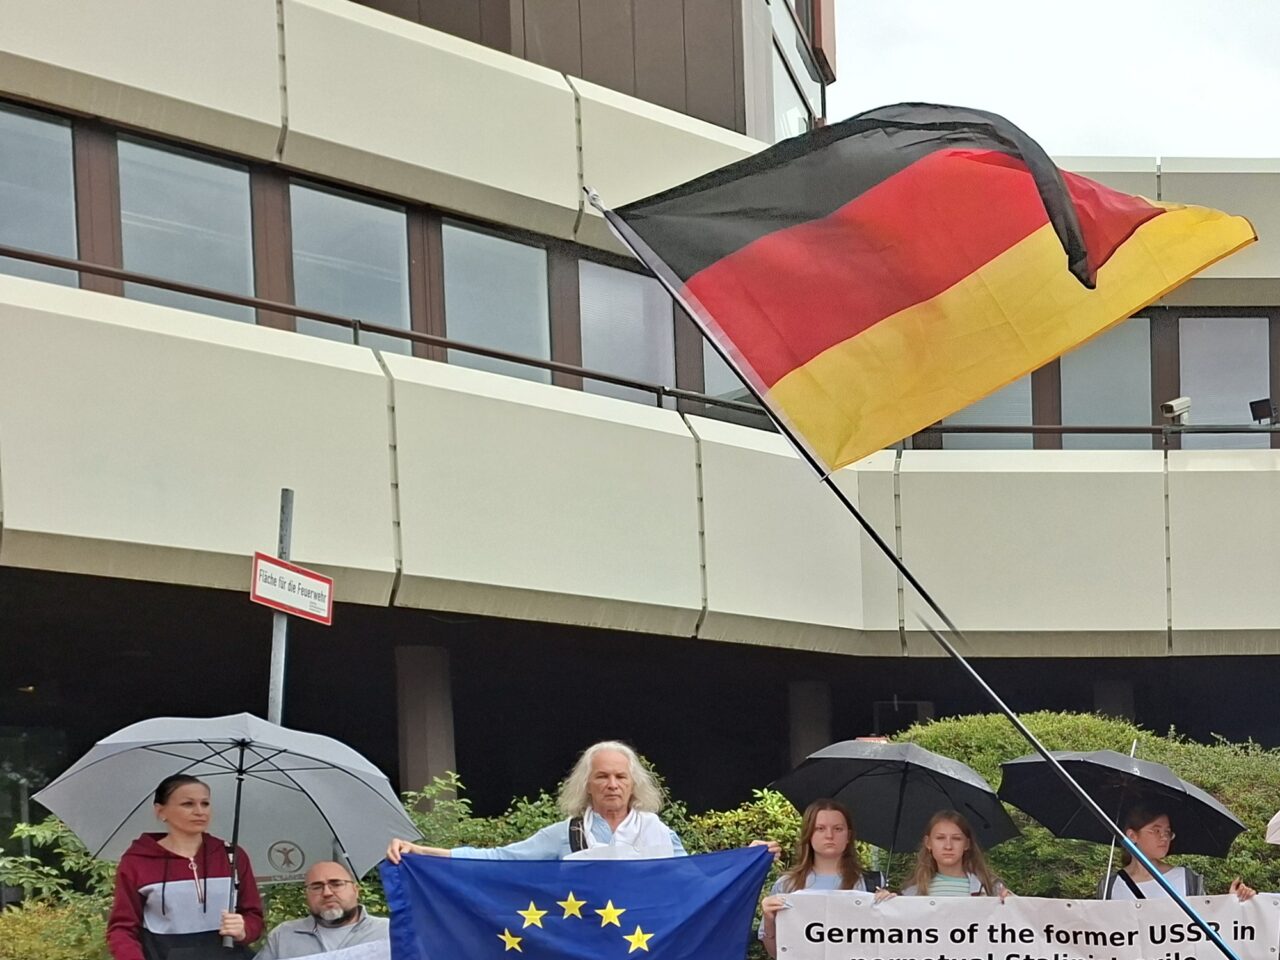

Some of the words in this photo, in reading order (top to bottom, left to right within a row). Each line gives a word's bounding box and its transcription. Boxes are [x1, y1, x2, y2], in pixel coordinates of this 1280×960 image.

[805, 923, 938, 943] Germans
[950, 923, 978, 943] of
[987, 923, 1034, 943] the
[1044, 925, 1138, 946] former
[1234, 921, 1254, 940] in
